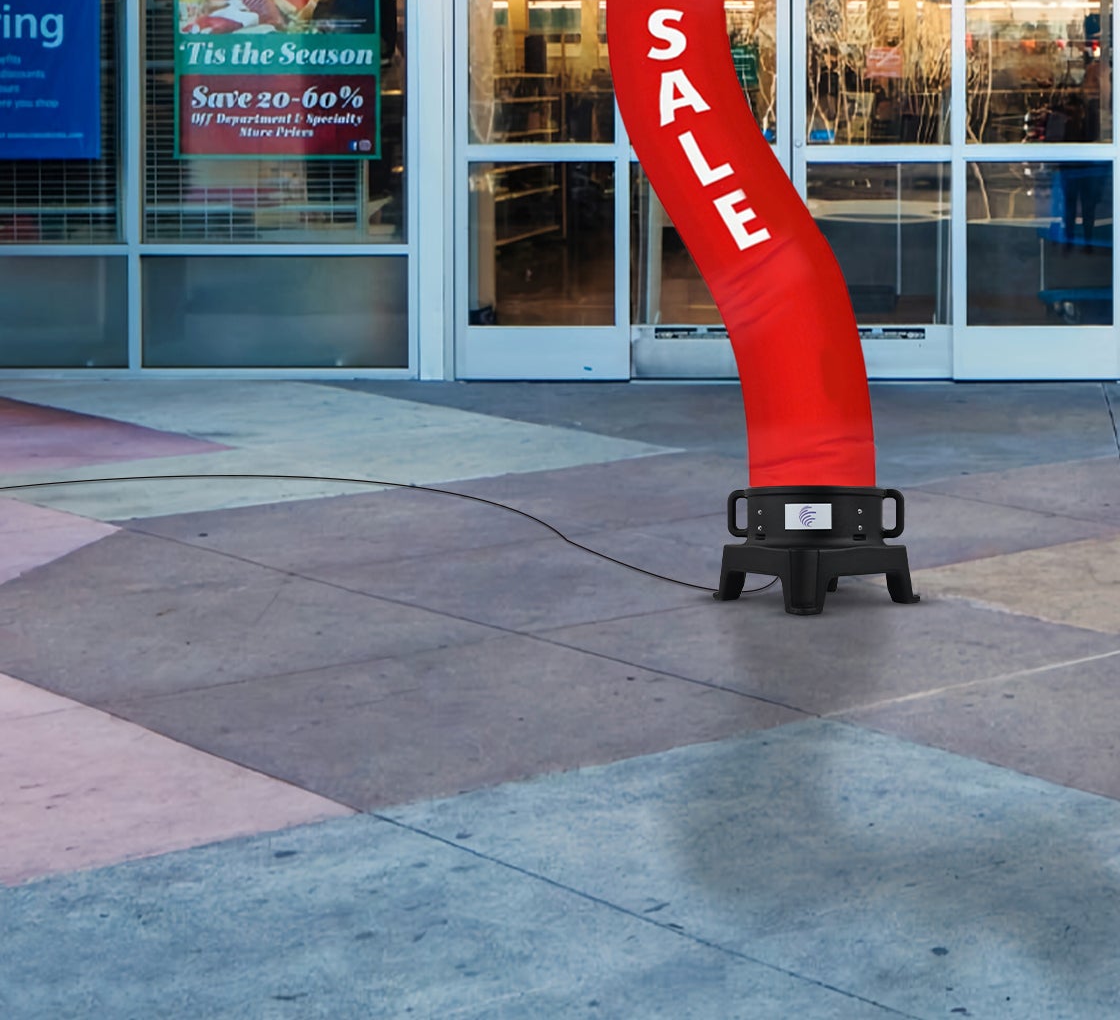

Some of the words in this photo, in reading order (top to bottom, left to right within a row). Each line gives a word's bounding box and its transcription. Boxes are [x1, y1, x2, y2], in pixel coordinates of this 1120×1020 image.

[0, 4, 64, 48] ing
[231, 42, 275, 65] the
[279, 42, 374, 66] Season
[191, 85, 252, 110] Save
[256, 85, 364, 110] 20-60%
[191, 112, 213, 127] Off
[216, 112, 291, 126] Department
[306, 112, 363, 128] Specialty
[647, 9, 772, 251] SALE
[239, 127, 277, 138] Store
